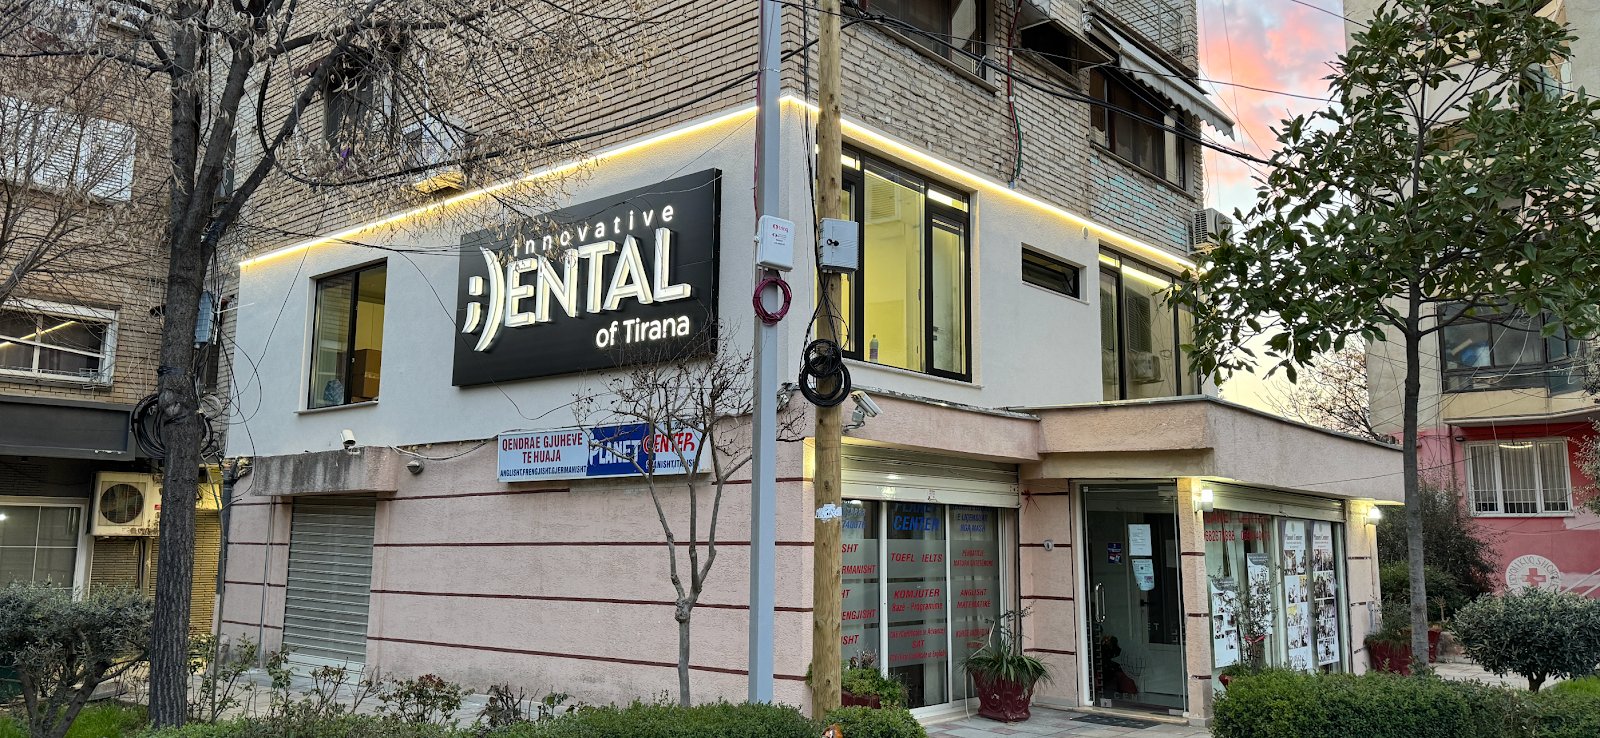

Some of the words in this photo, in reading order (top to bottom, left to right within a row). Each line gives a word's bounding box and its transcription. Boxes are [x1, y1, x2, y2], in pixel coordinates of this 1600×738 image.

[513, 204, 674, 257] innovative
[596, 321, 618, 348] of
[622, 314, 690, 344] Tirana
[543, 432, 583, 449] GJUHEVE
[523, 451, 532, 464] TE
[533, 449, 561, 463] HUAJA
[589, 439, 640, 466] PLANET
[893, 515, 940, 532] CENTER
[891, 552, 915, 563] TOEFL
[922, 553, 943, 563] IELTS
[842, 564, 876, 575] RMANISHT
[894, 588, 940, 599] KOMJUTER
[960, 588, 987, 597] ANGLISHT
[842, 609, 877, 620] ENGJISHT
